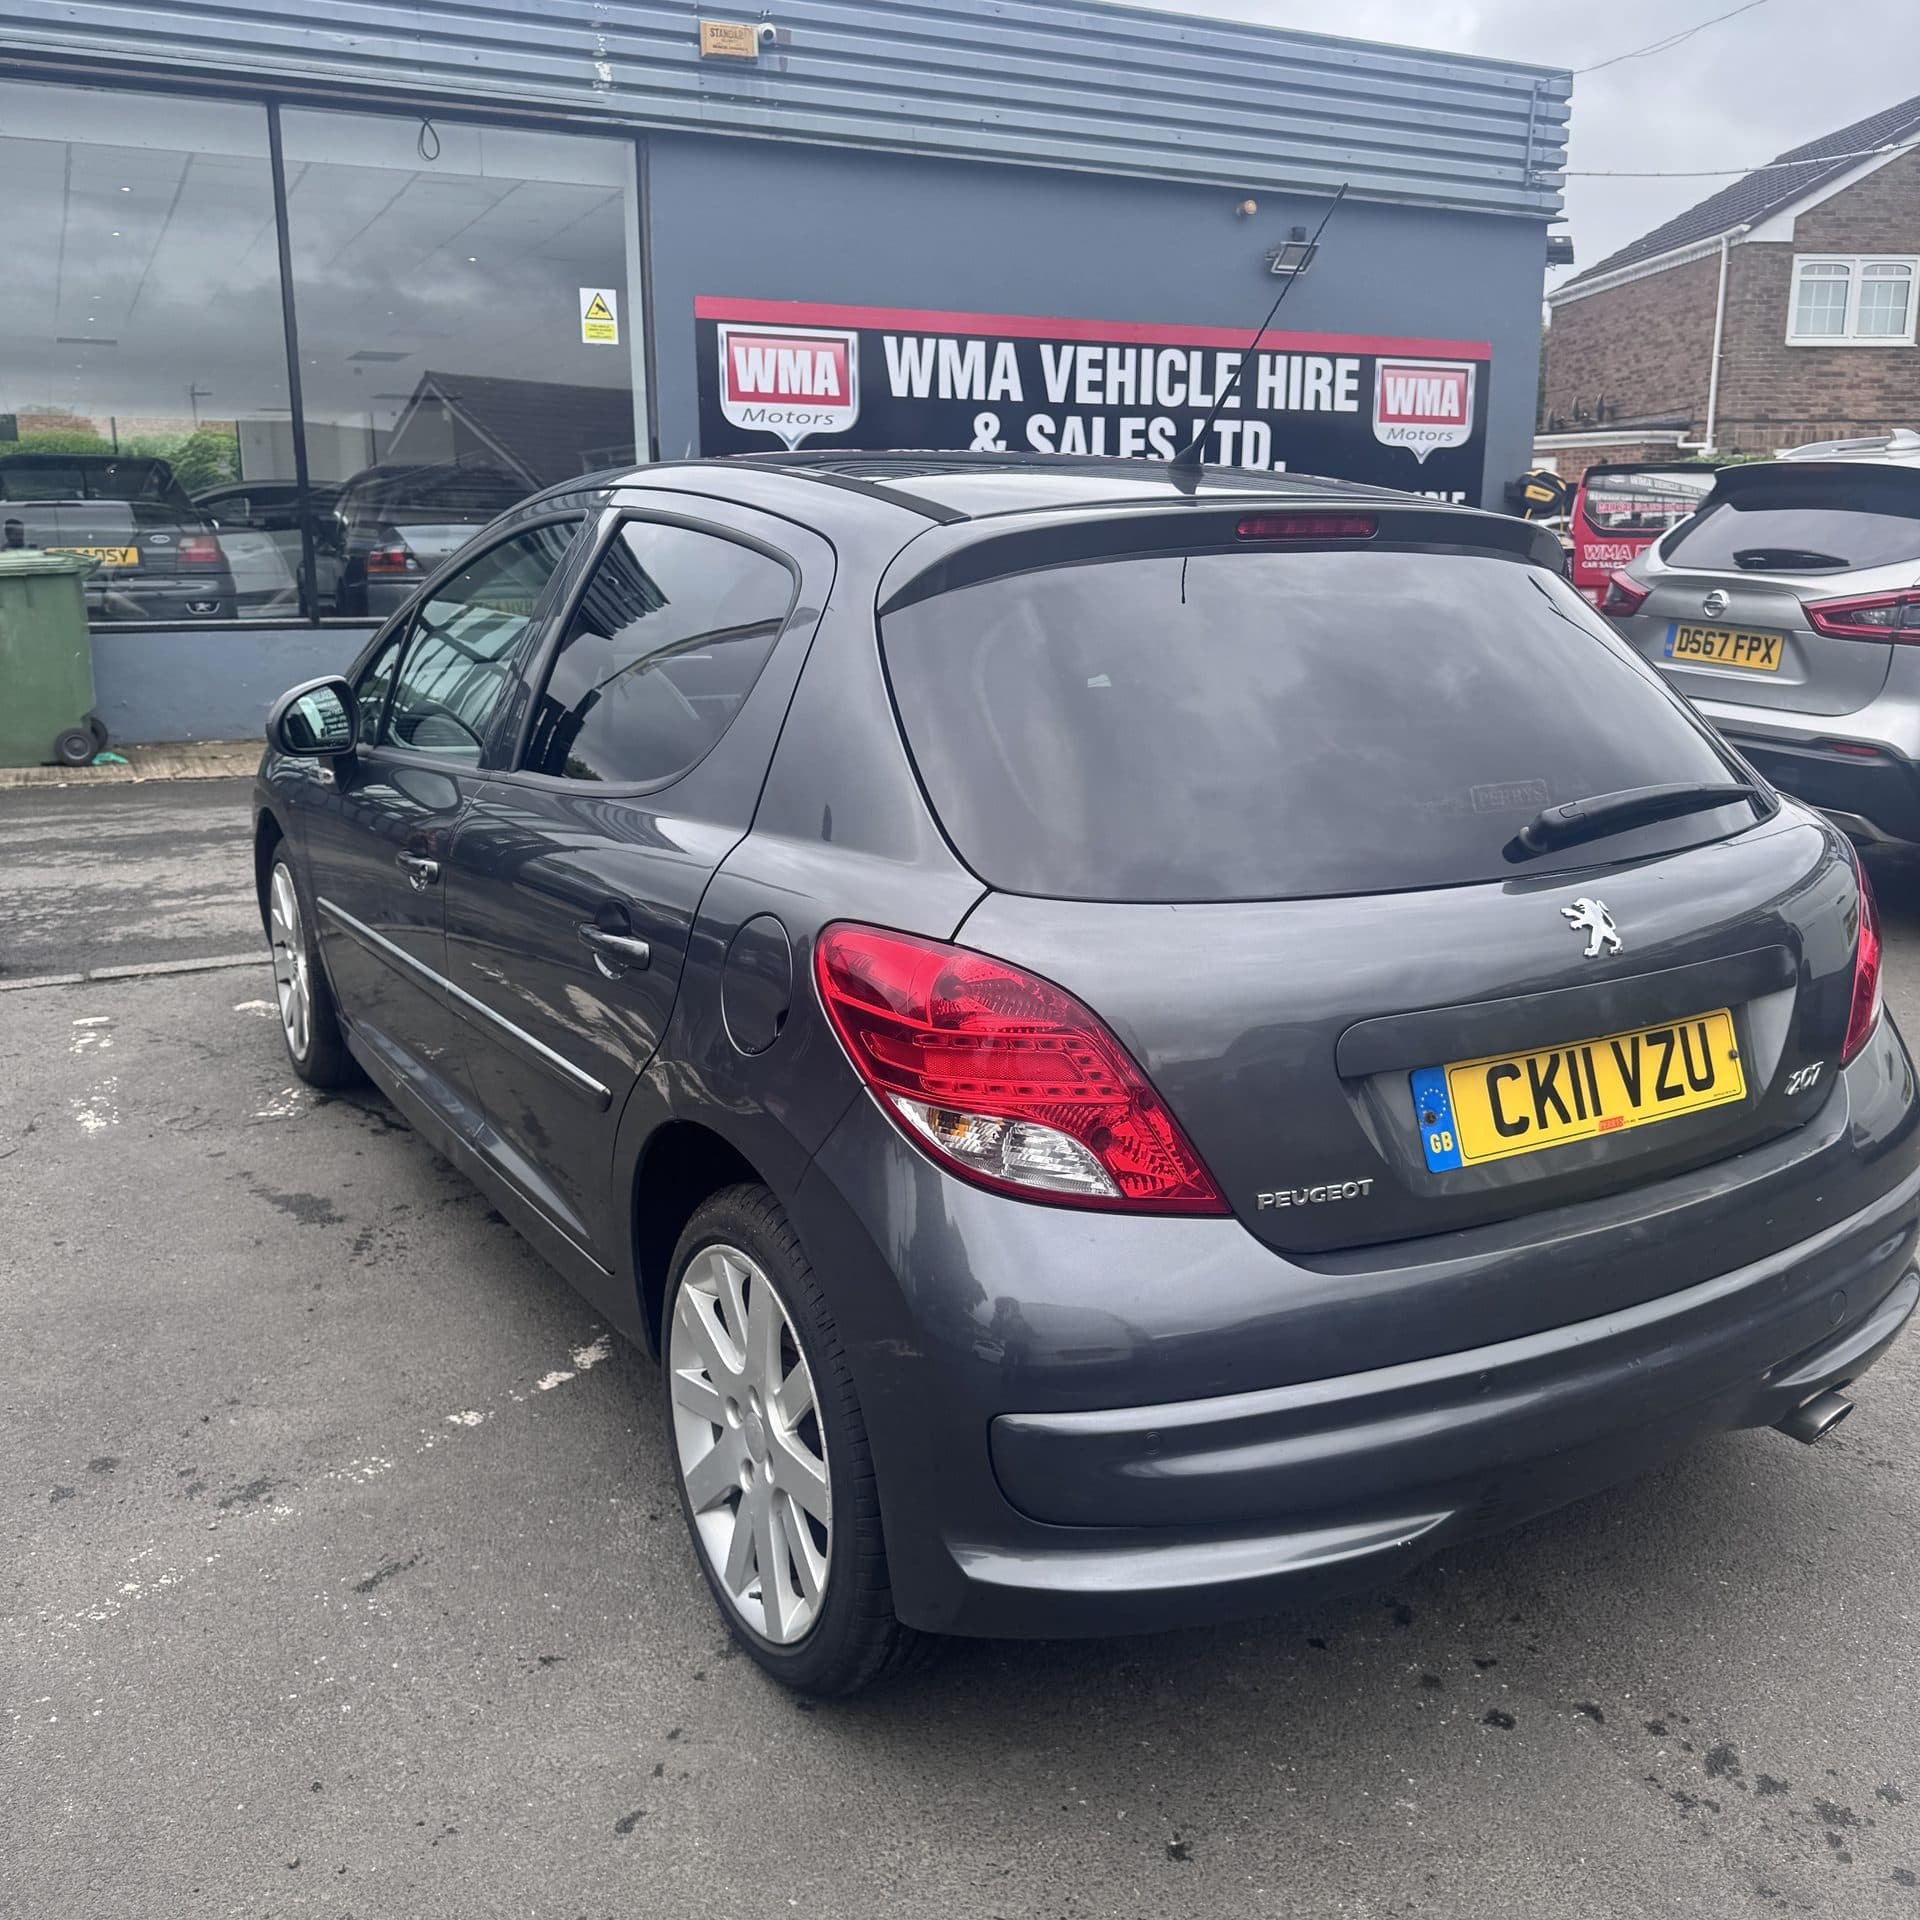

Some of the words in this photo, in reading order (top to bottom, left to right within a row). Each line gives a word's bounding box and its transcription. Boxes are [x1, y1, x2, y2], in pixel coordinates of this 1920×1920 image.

[733, 346, 841, 397] WMA
[883, 335, 1024, 402] WMA
[1039, 344, 1243, 409] VEHICLE
[1256, 354, 1361, 413] HIRE
[1385, 376, 1461, 418] WMA
[741, 407, 835, 426] Motors
[969, 411, 1008, 452] &
[1025, 413, 1178, 461] SALES
[1386, 427, 1455, 443] Motors
[1583, 544, 1632, 561] WMA
[1677, 628, 1730, 657] DS67
[1733, 634, 1777, 664] FPX
[1486, 1047, 1603, 1138] CK11
[1610, 1022, 1715, 1108] VZU
[1429, 1131, 1454, 1154] GB
[1257, 1178, 1374, 1210] PEUGEOT
